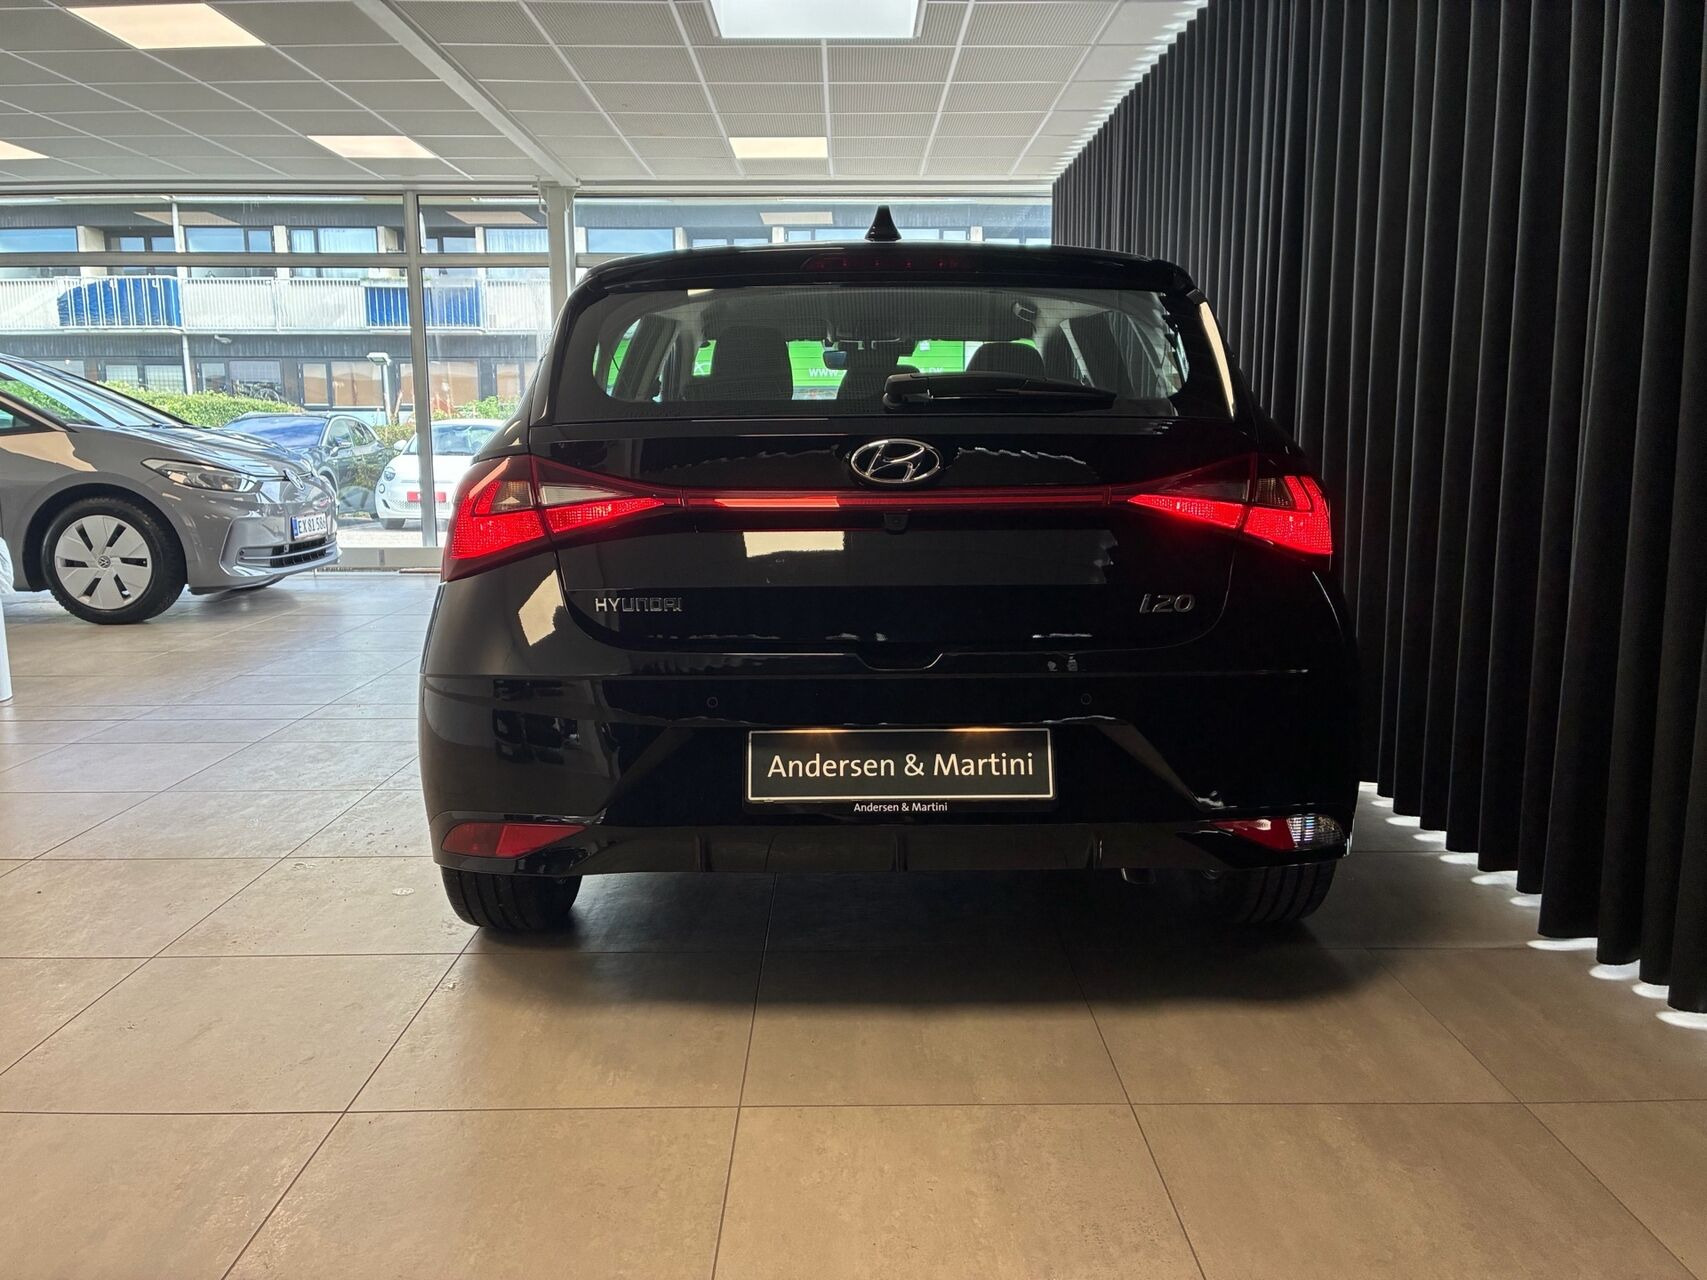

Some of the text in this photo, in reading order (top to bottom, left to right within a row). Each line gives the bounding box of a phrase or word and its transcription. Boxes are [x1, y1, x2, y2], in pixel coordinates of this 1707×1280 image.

[595, 597, 682, 612] HYUNDAI
[1139, 594, 1195, 613] i20
[767, 752, 1033, 778] Andersen & Martini
[854, 802, 948, 812] Andersen & Martini
